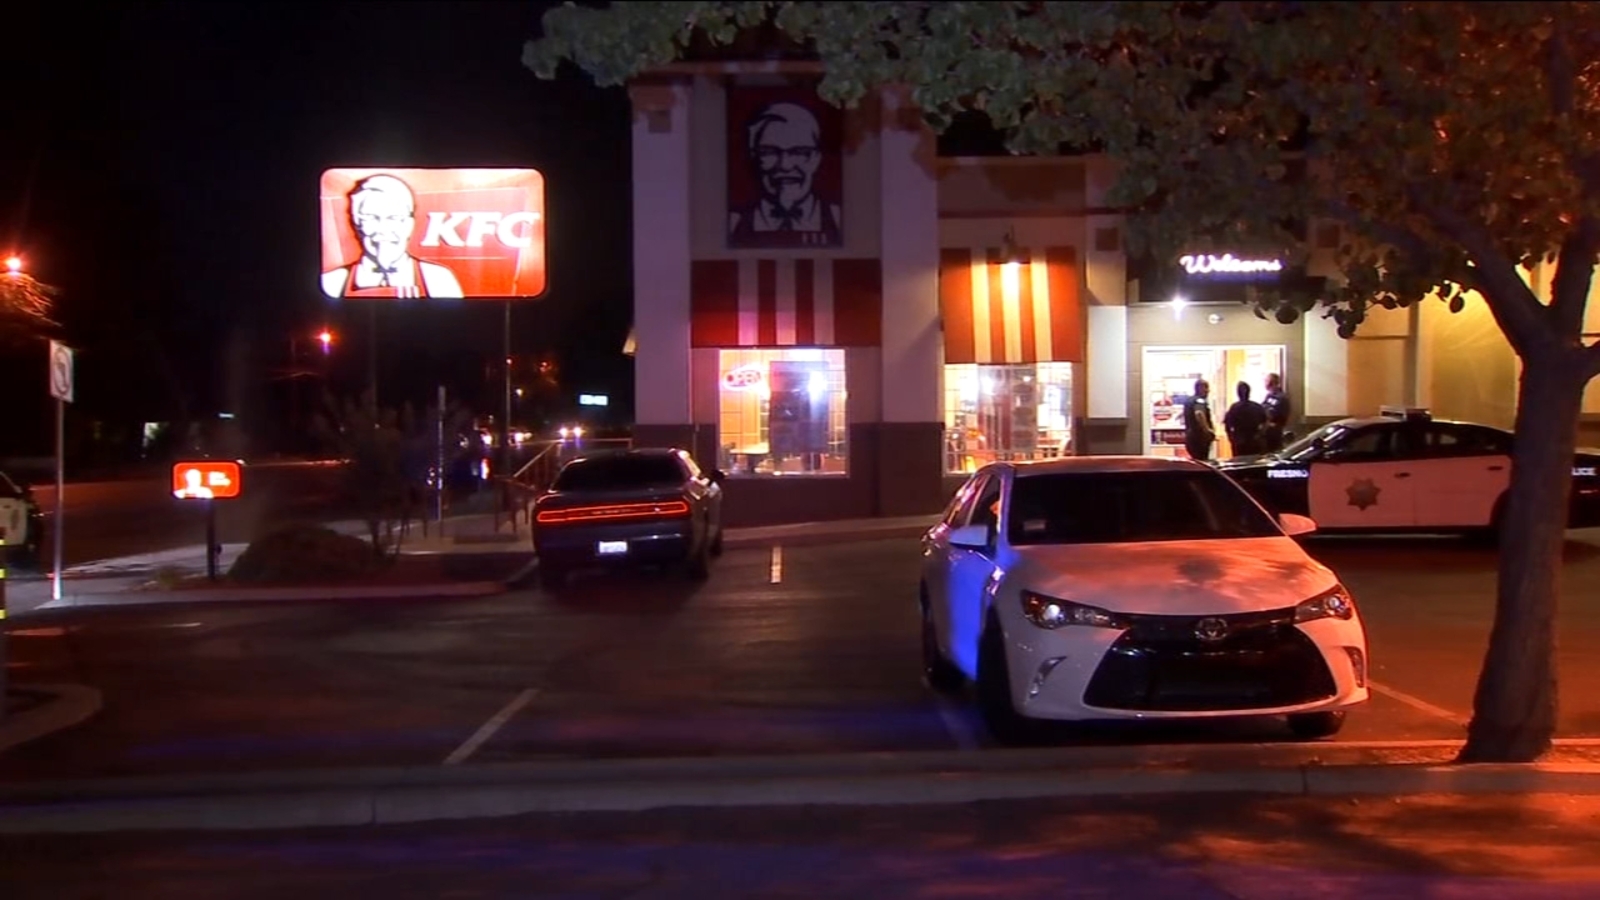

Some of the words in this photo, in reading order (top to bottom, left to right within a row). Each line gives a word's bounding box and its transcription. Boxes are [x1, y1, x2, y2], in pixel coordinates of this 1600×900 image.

[420, 211, 541, 248] KFC
[723, 367, 762, 388] OPEN
[1267, 469, 1309, 478] FRESNO
[1571, 467, 1597, 476] LICE
